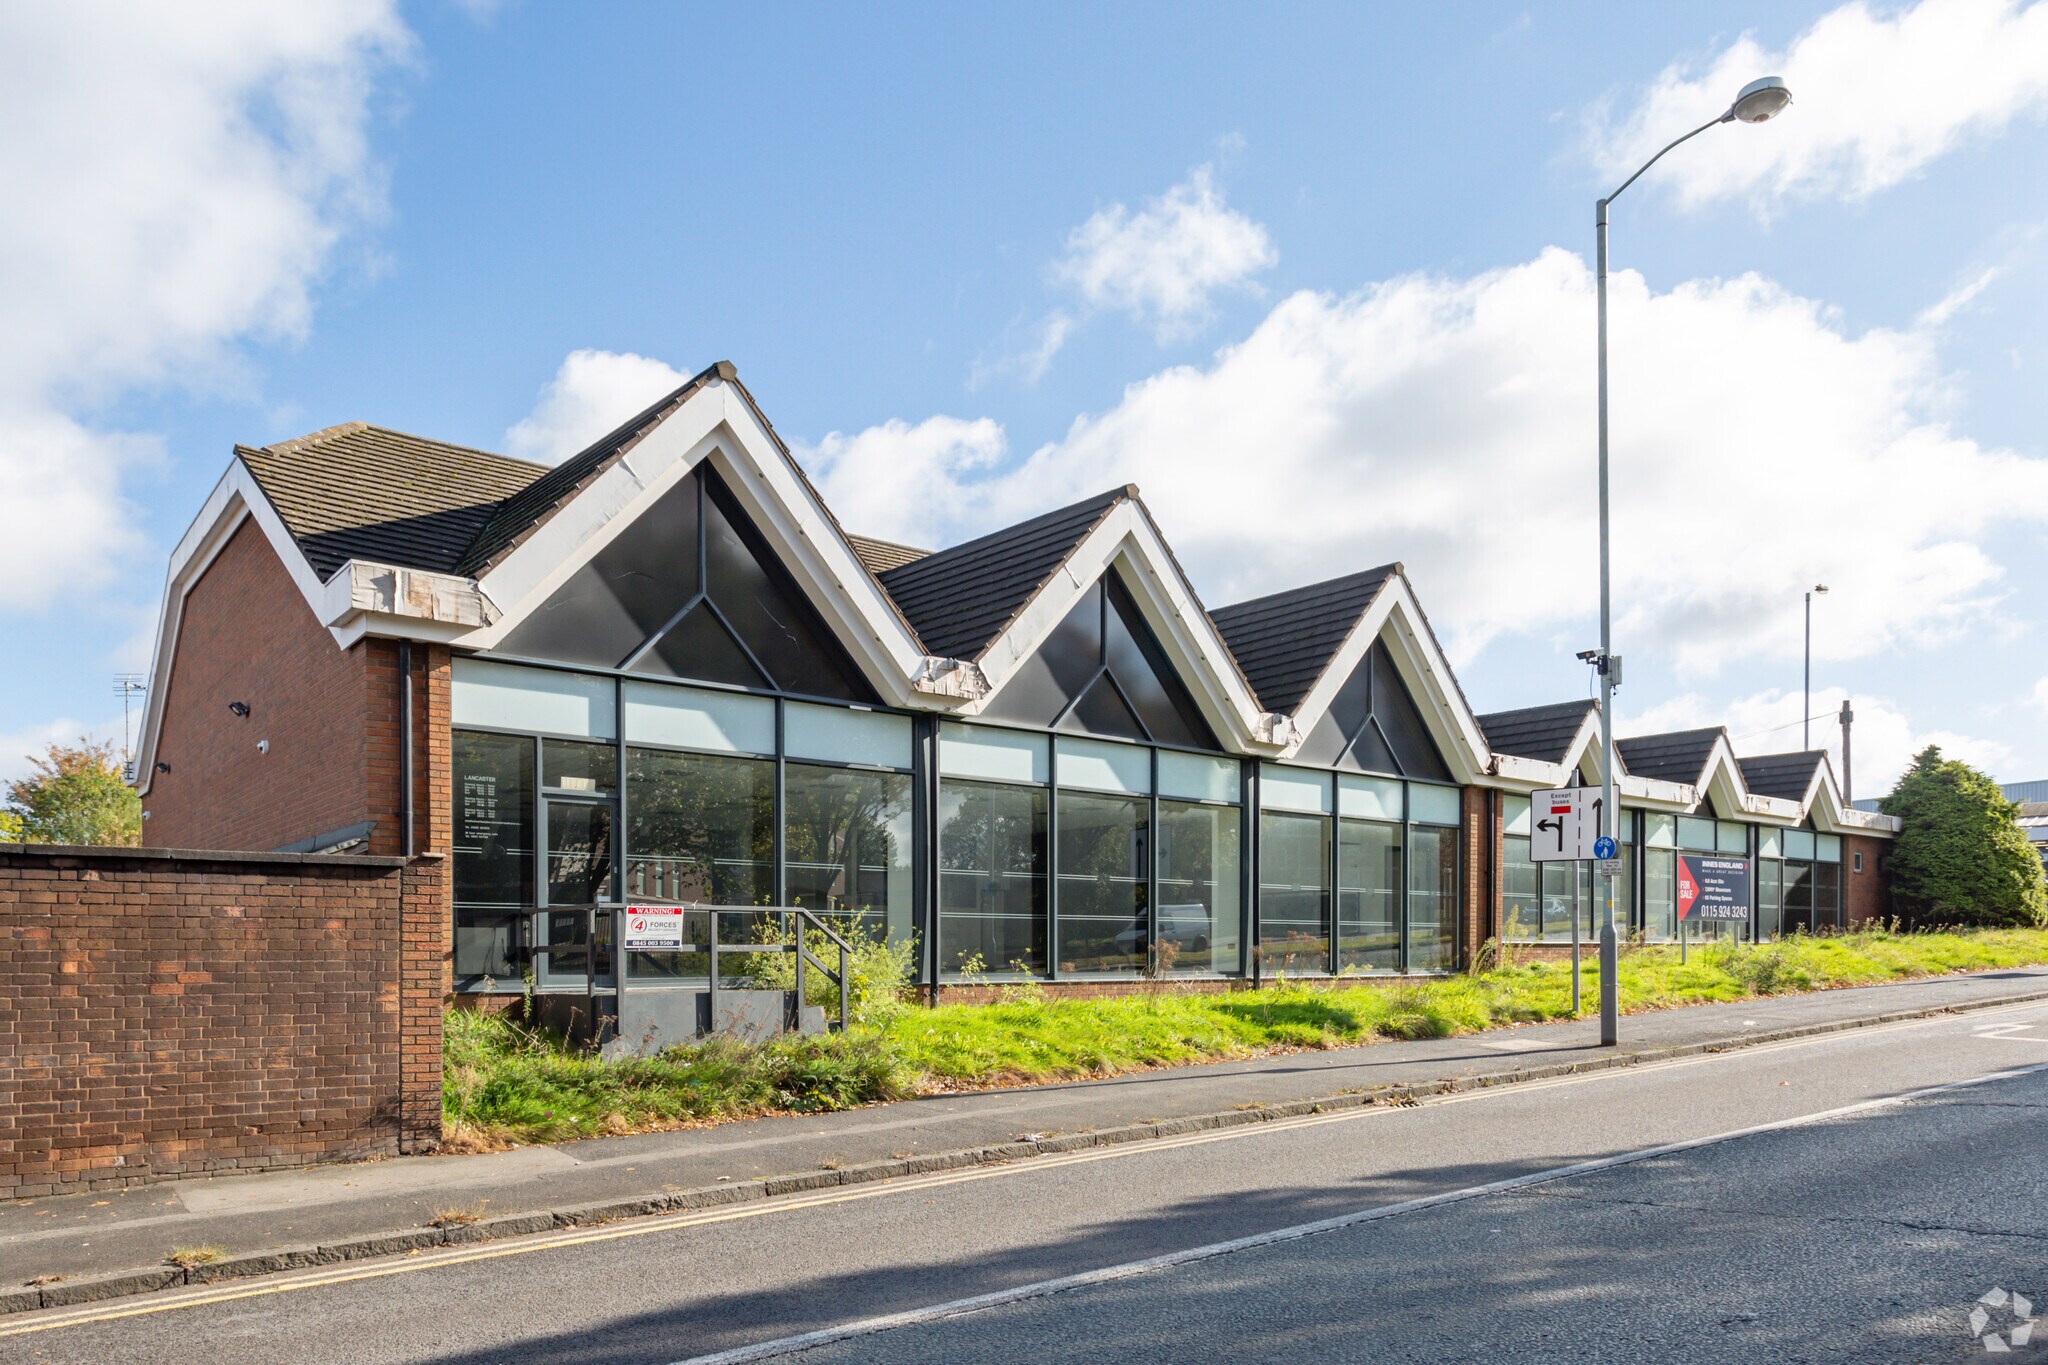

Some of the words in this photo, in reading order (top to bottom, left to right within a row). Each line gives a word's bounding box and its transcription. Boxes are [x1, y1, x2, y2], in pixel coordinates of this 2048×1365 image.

[1680, 880, 1690, 889] FOR
[1680, 890, 1693, 899] SALE
[1701, 905, 1717, 917] 0115
[1719, 906, 1730, 917] 924
[1732, 906, 1747, 918] 3243
[635, 921, 643, 930] 4
